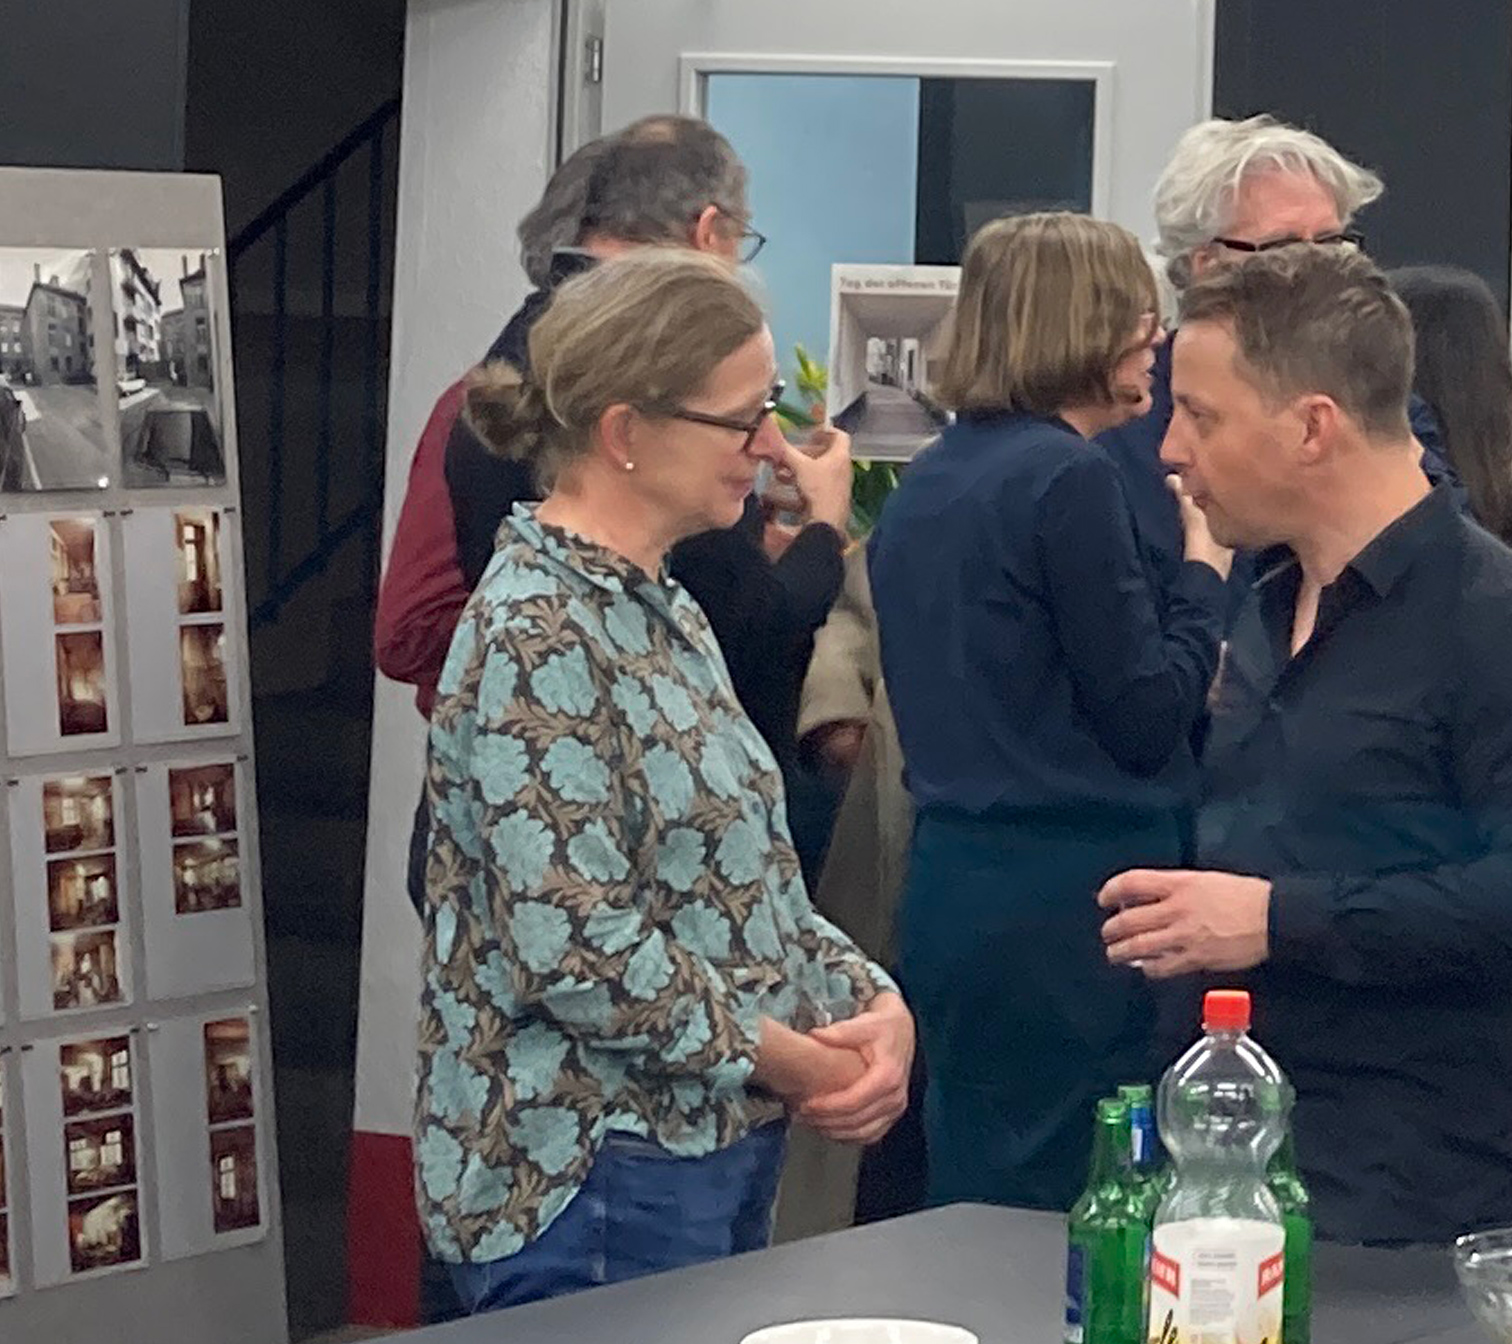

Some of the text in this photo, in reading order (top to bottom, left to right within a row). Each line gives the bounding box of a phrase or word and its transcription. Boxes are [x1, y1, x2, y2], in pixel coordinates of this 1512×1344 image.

[840, 276, 862, 290] Tag
[865, 278, 884, 289] der
[887, 278, 936, 290] offenen
